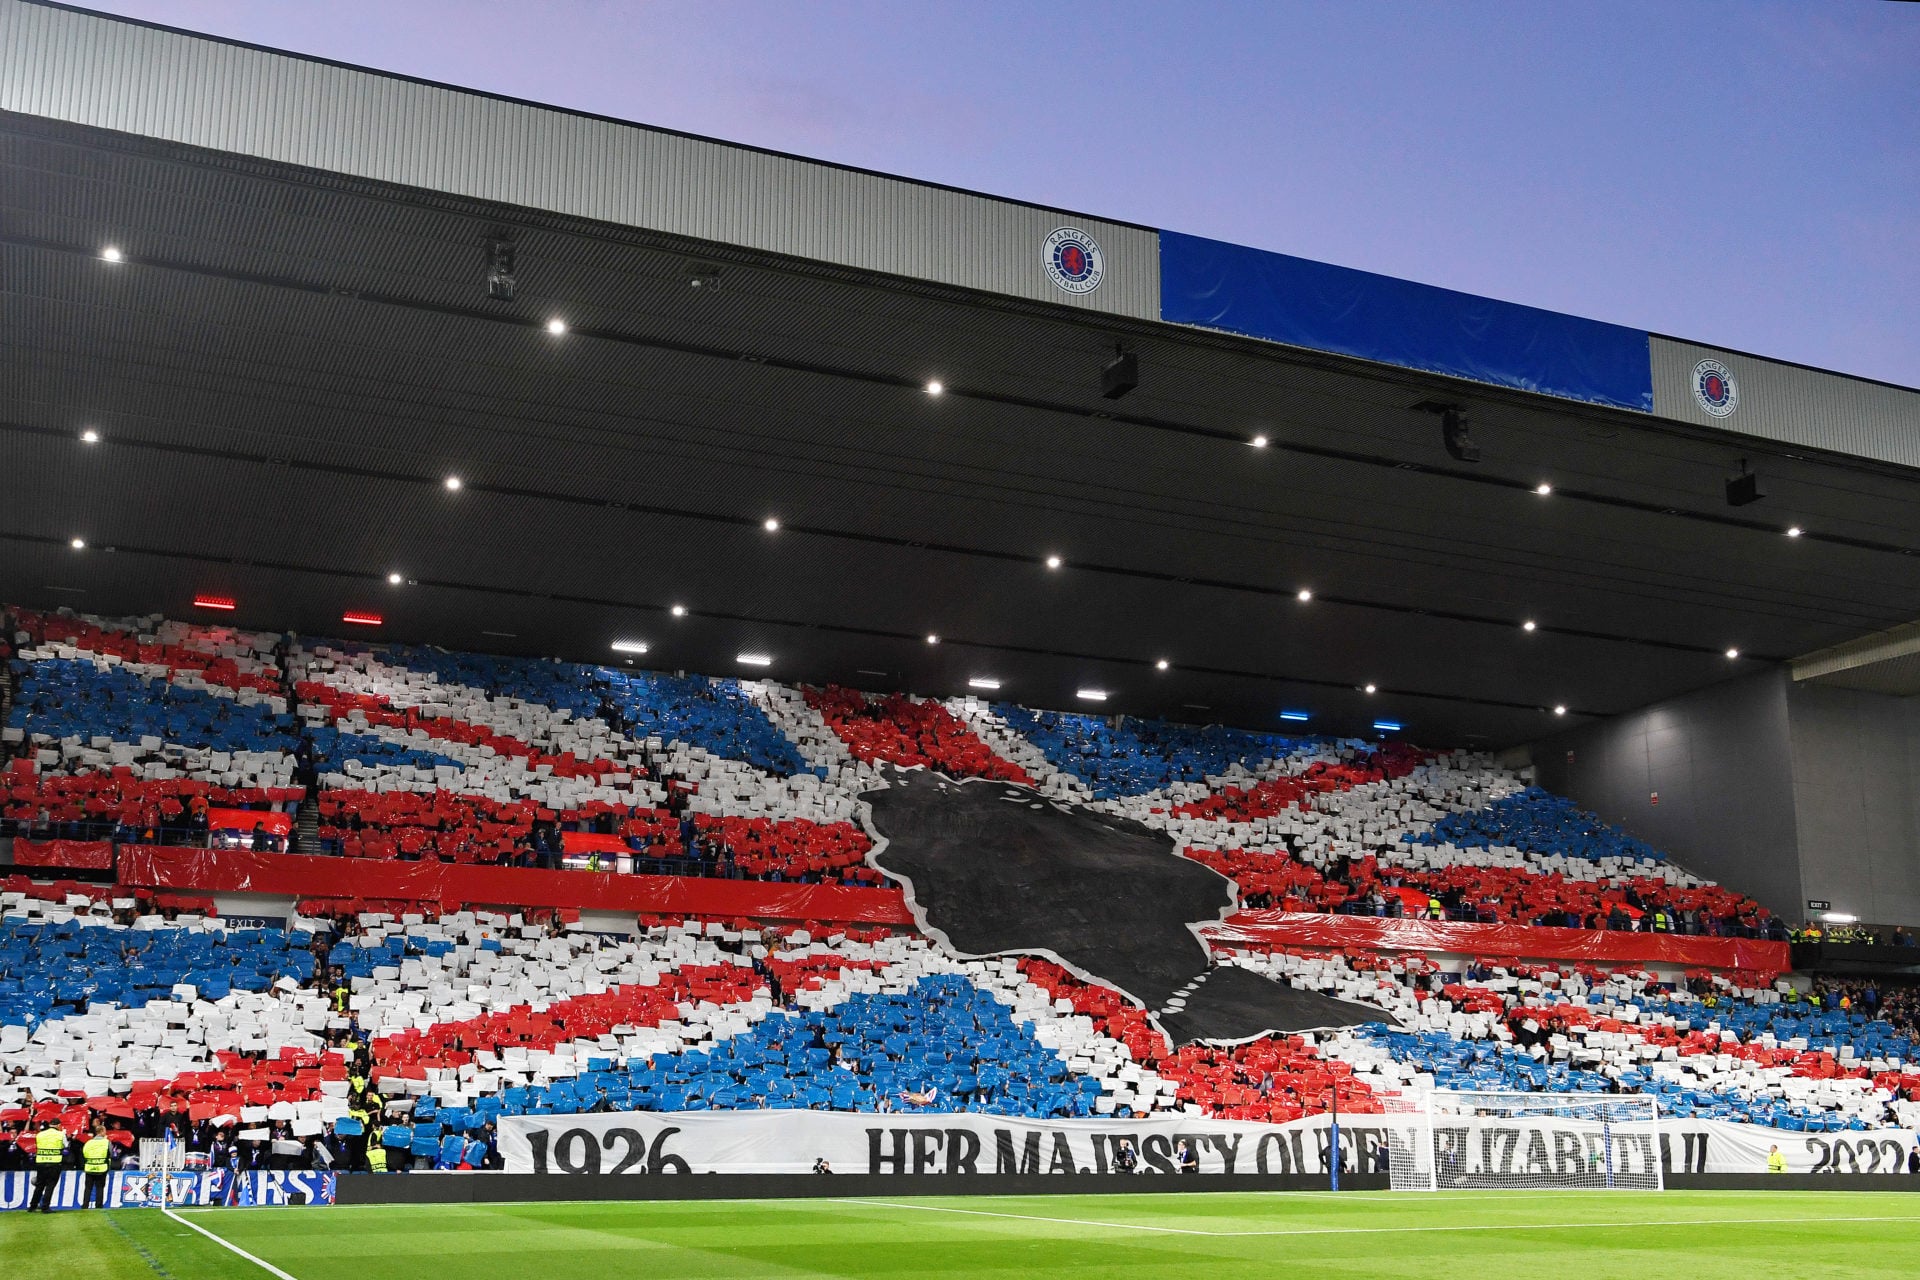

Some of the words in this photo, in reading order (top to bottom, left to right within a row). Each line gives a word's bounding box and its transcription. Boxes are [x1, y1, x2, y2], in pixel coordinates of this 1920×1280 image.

[1049, 230, 1098, 254] RANGERS
[1047, 261, 1085, 291] FOOTBALL
[1084, 270, 1101, 288] CLUB
[1696, 362, 1731, 382] RANGERS
[229, 918, 256, 928] EXIT
[260, 919, 266, 928] 2
[526, 1127, 692, 1175] 1926
[866, 1128, 978, 1174] HER
[1805, 1137, 1905, 1174] 2022
